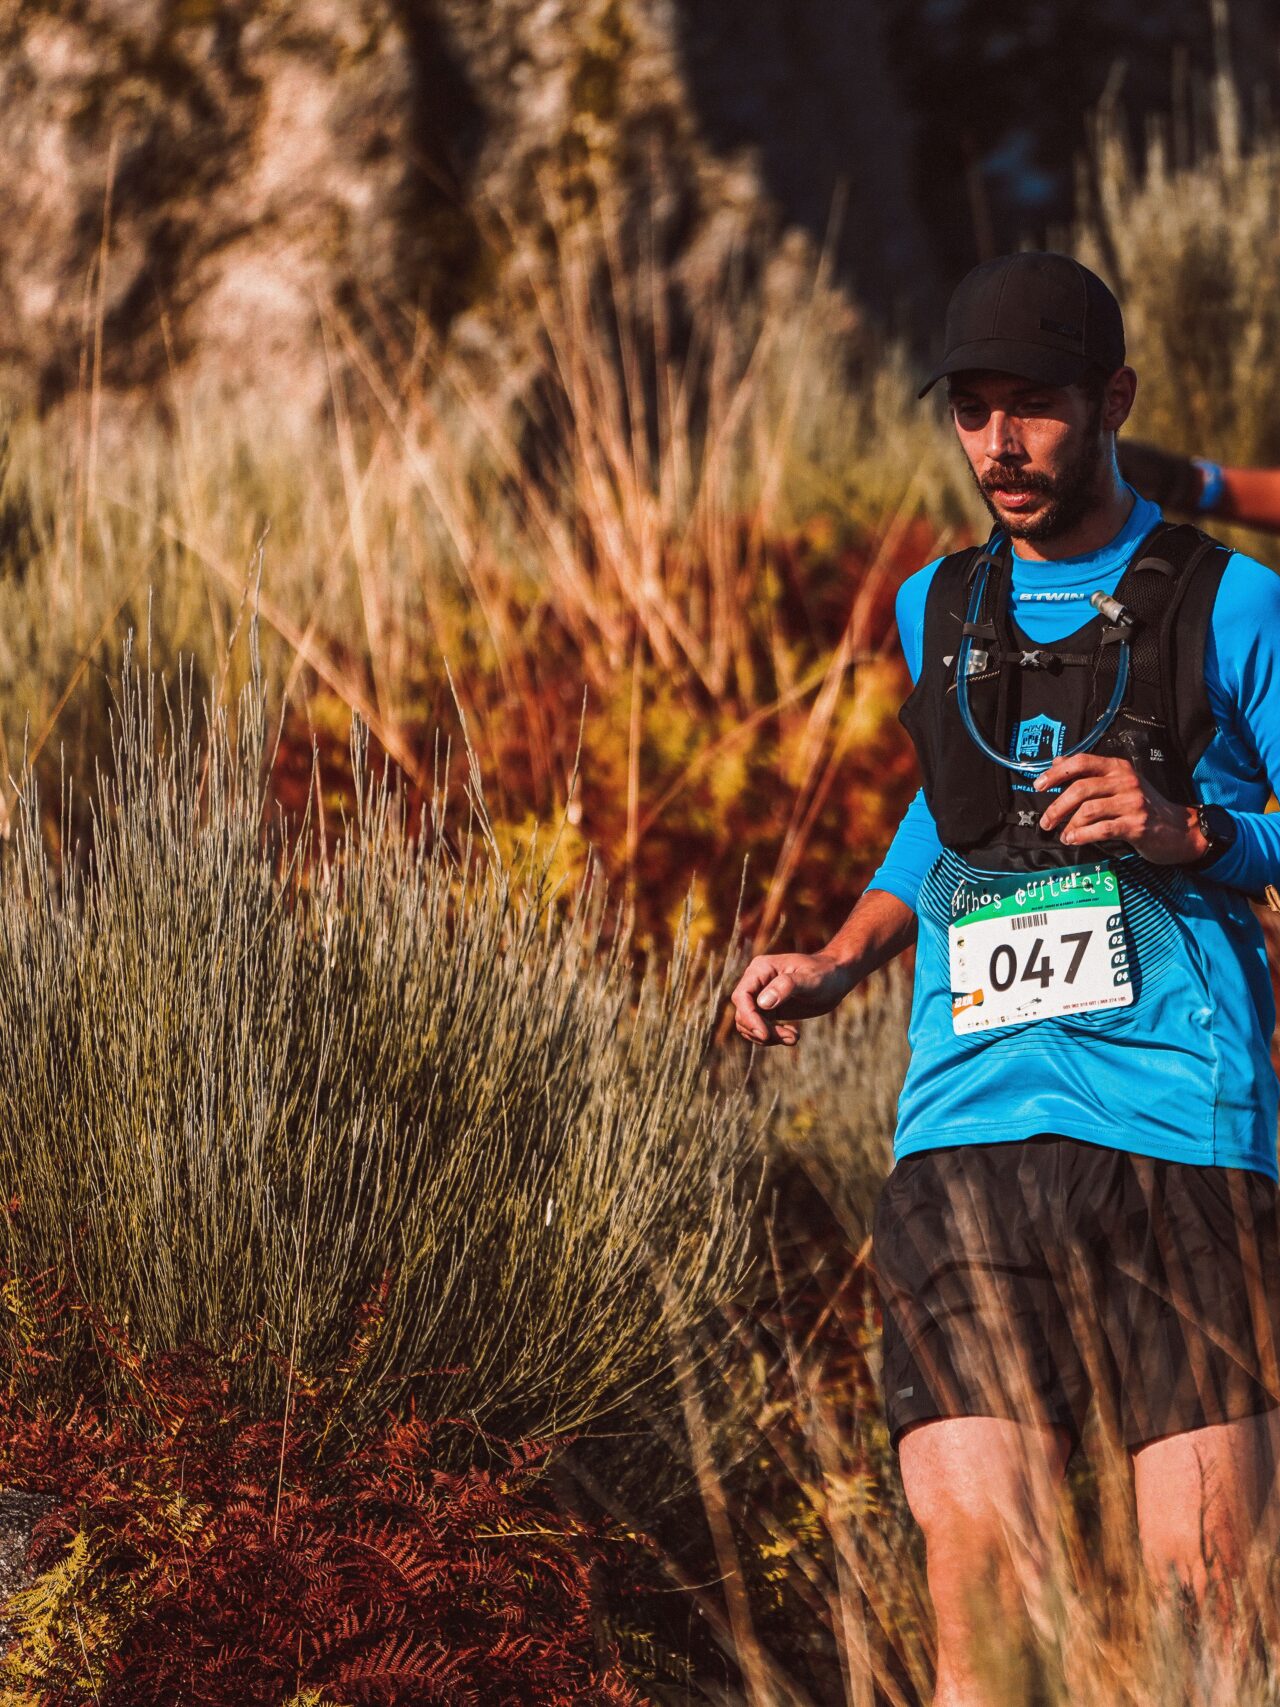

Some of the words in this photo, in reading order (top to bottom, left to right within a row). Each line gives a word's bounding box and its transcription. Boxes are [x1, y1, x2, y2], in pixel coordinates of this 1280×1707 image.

[1109, 917, 1120, 927] 01
[1111, 935, 1123, 945] 02
[989, 930, 1093, 992] 047
[1114, 954, 1126, 964] 03
